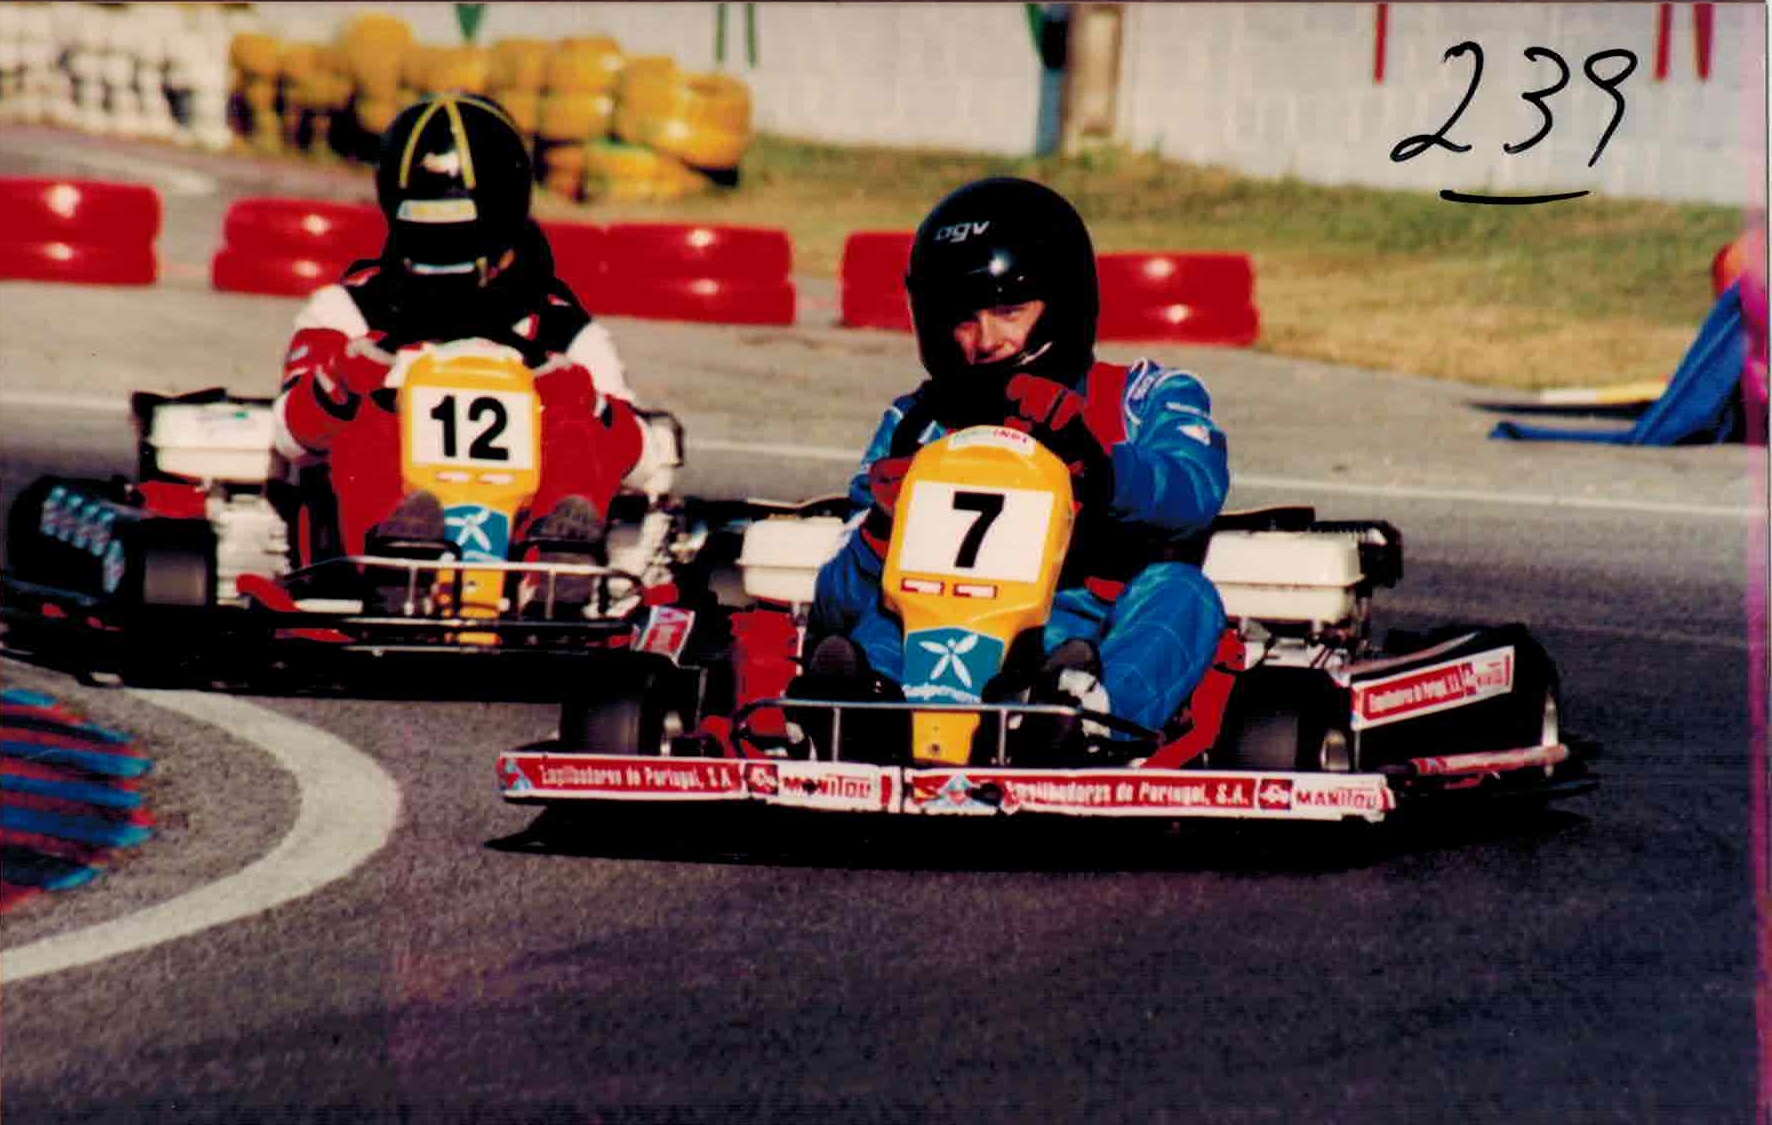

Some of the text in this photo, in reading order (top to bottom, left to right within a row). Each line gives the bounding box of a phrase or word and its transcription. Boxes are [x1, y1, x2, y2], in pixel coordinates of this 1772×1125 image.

[933, 220, 991, 243] agv
[430, 394, 510, 461] 12
[952, 490, 1006, 569] 7
